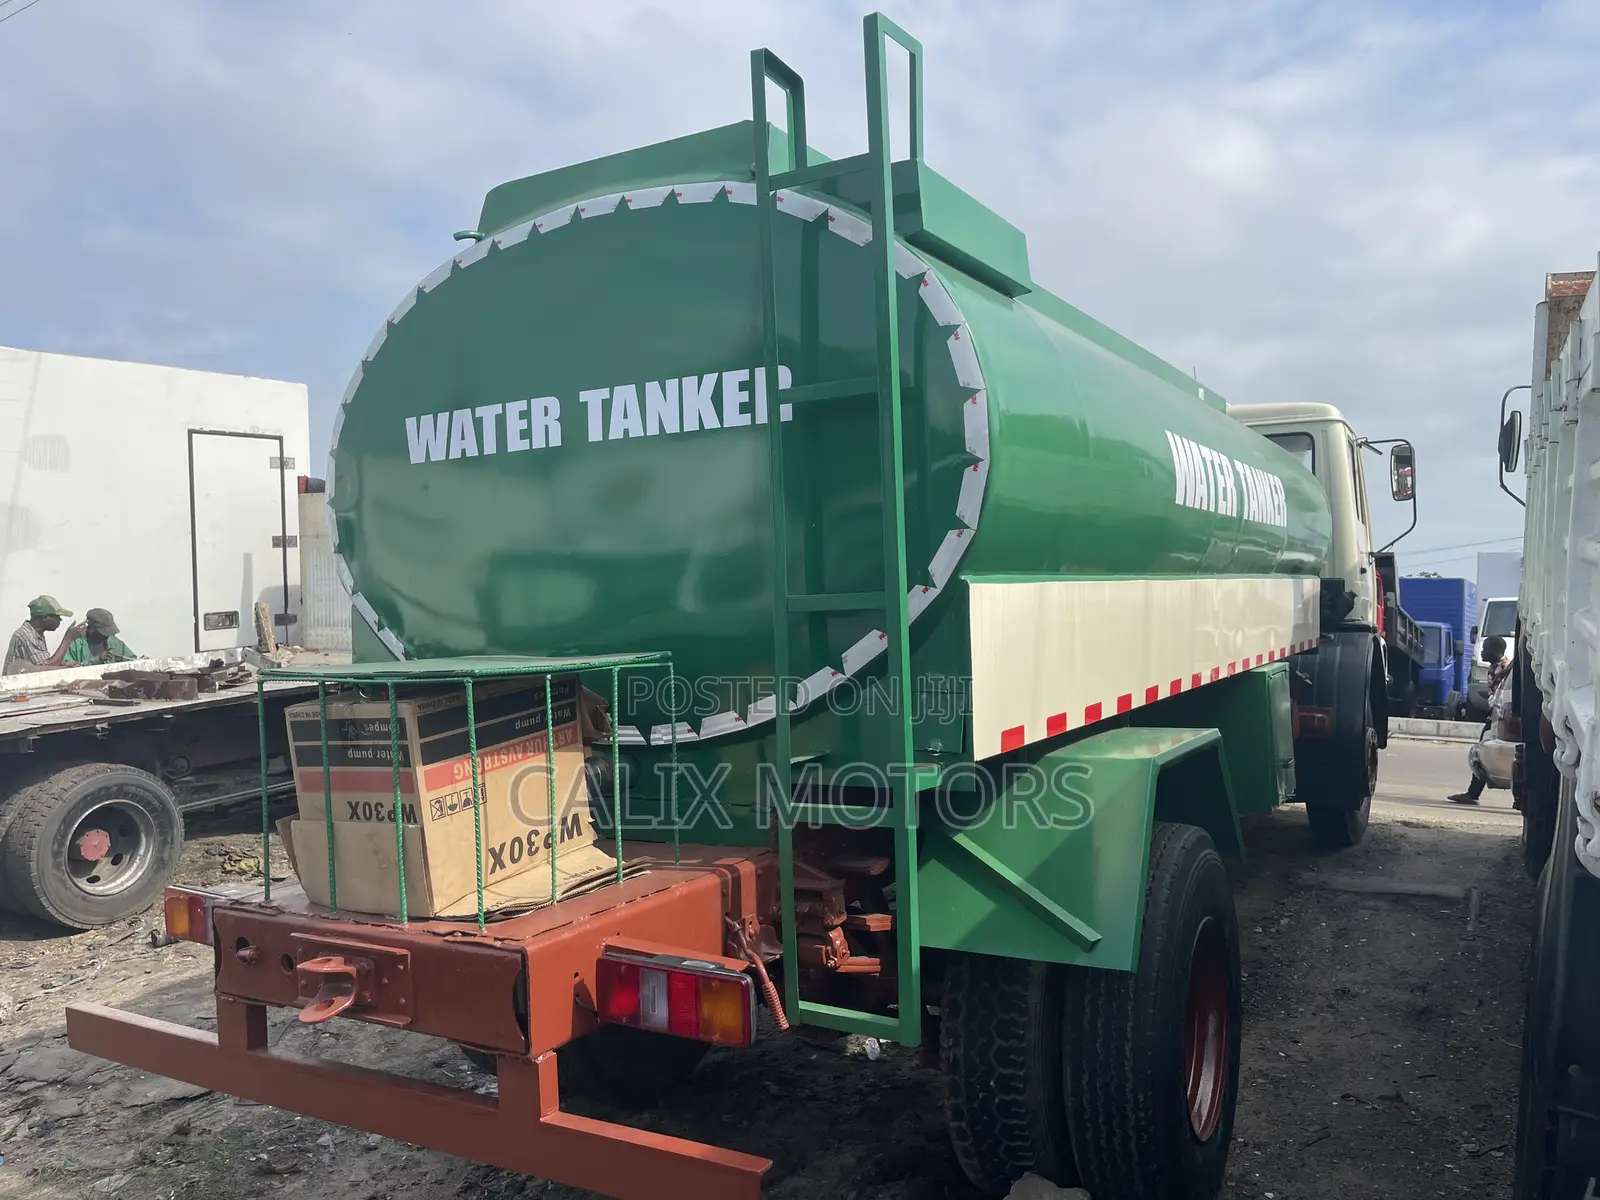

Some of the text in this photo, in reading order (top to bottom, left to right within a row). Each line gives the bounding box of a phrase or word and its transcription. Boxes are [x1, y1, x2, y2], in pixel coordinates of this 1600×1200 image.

[405, 364, 793, 465] WATER TANKER
[1165, 429, 1287, 528] WATER TANKER
[532, 685, 570, 700] Pomes
[514, 707, 571, 730] Watr pump
[346, 747, 374, 759] pump
[525, 728, 573, 756] ARHUR
[346, 800, 418, 824] WP30X
[488, 812, 583, 876] WP30X
